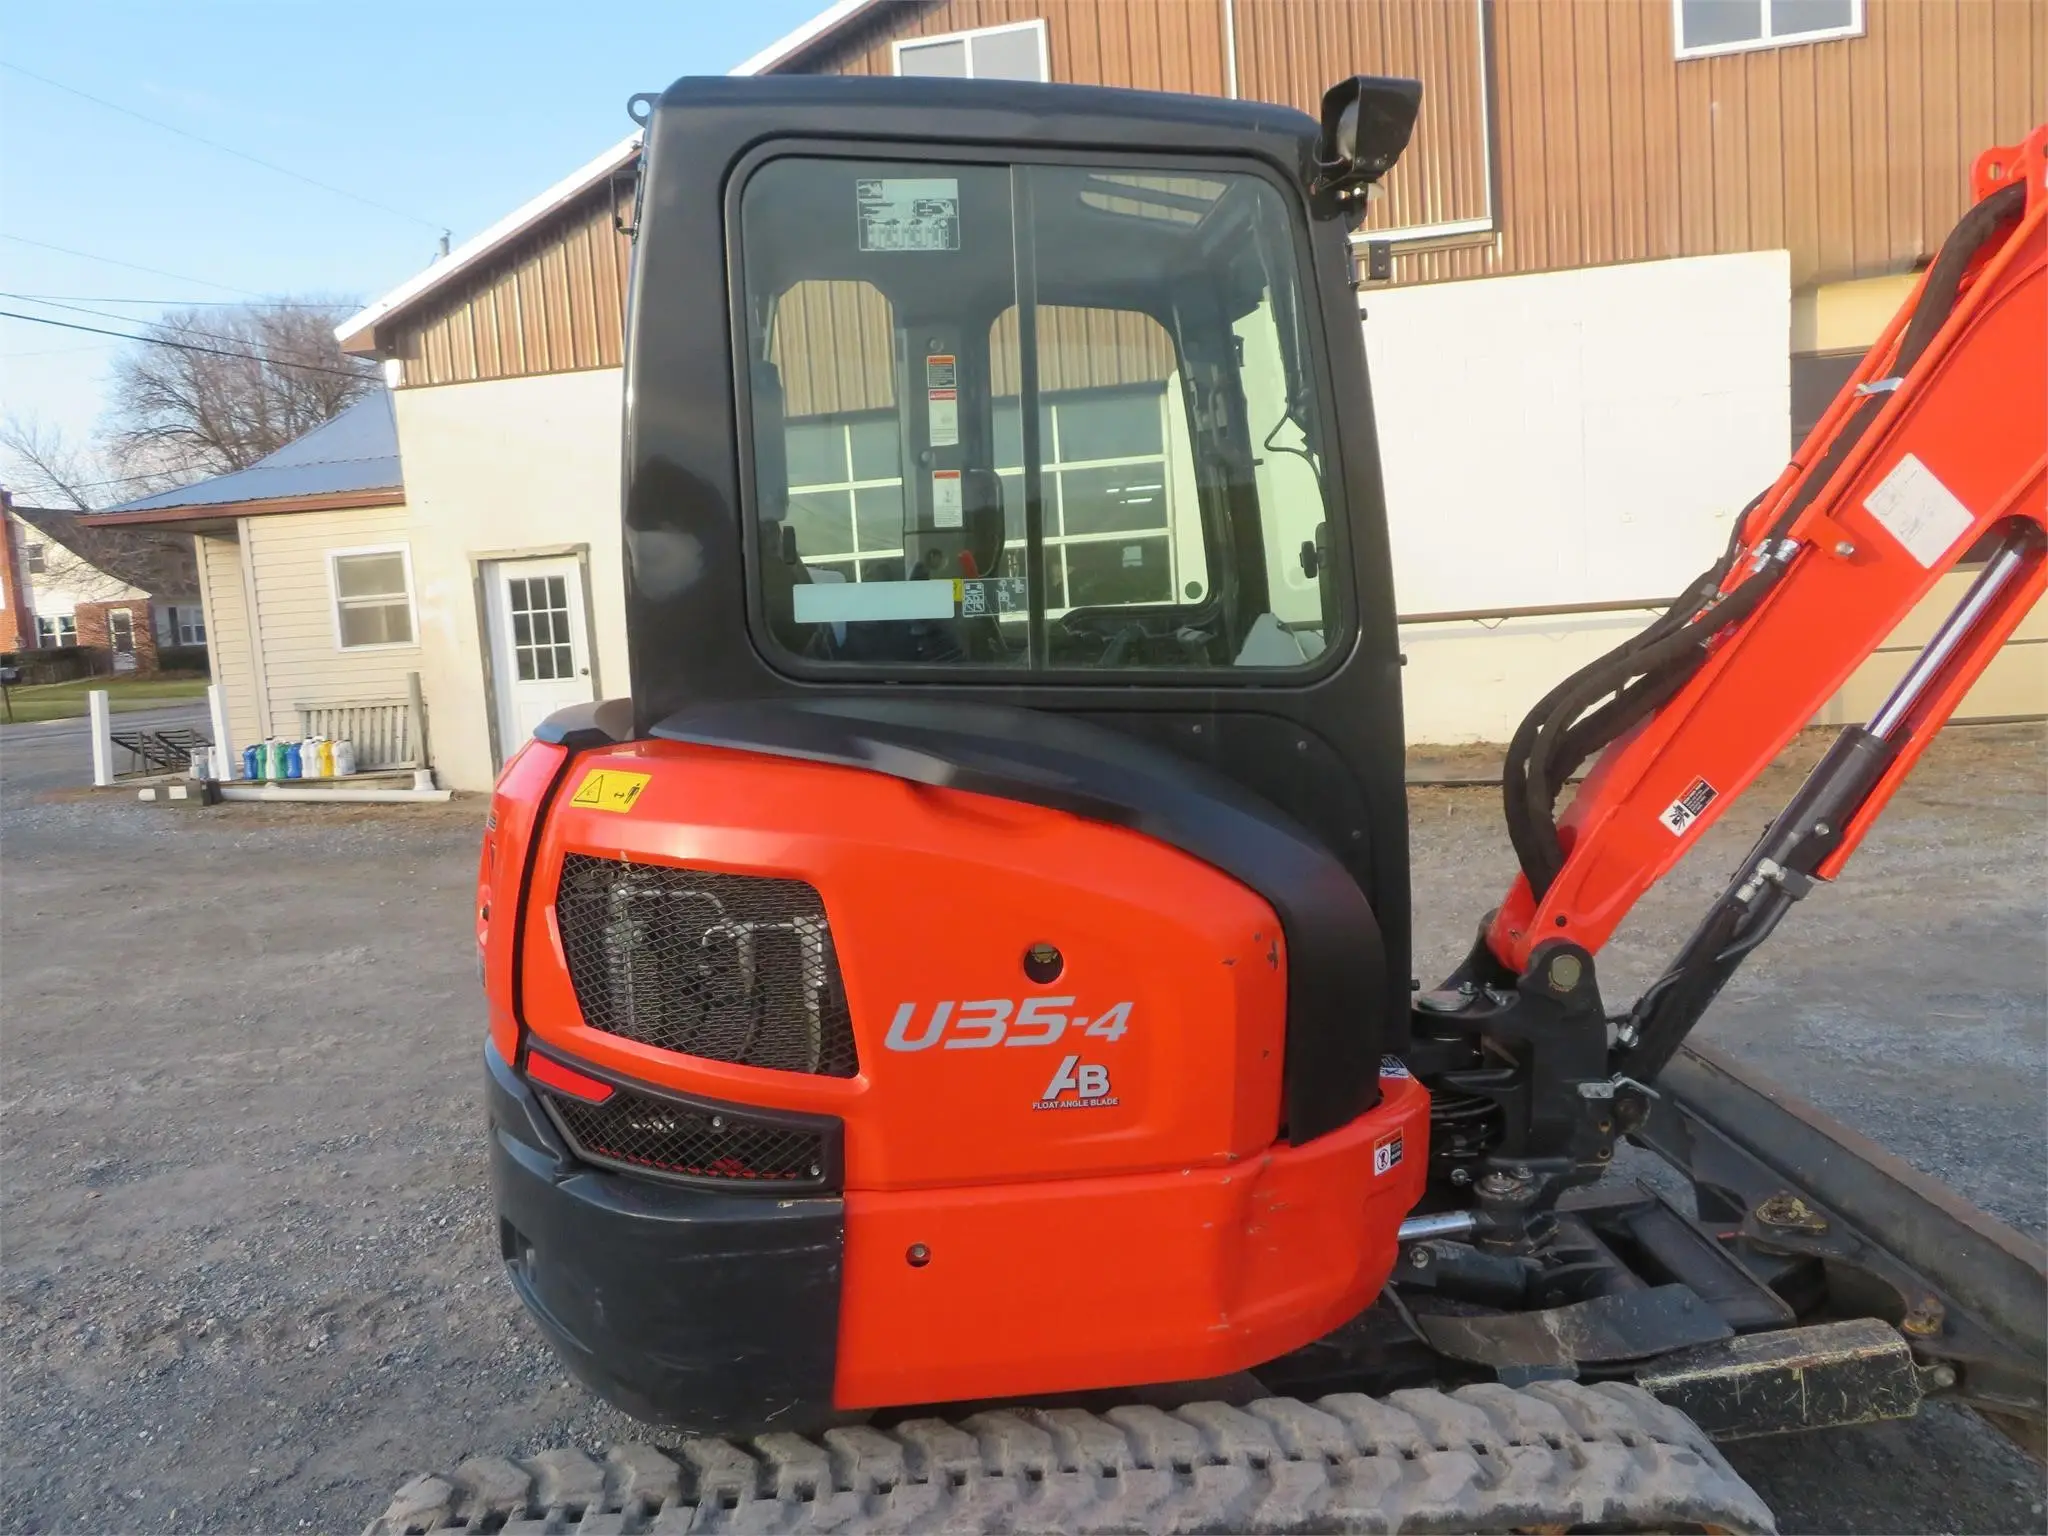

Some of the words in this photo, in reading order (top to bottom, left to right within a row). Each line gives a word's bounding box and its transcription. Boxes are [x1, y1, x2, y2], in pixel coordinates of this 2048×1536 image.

[884, 995, 1134, 1051] U35-4
[1042, 1055, 1111, 1100] AB
[1032, 1101, 1059, 1110] FLOAT
[1060, 1100, 1089, 1109] ANGLE
[1090, 1098, 1119, 1107] BLADE
